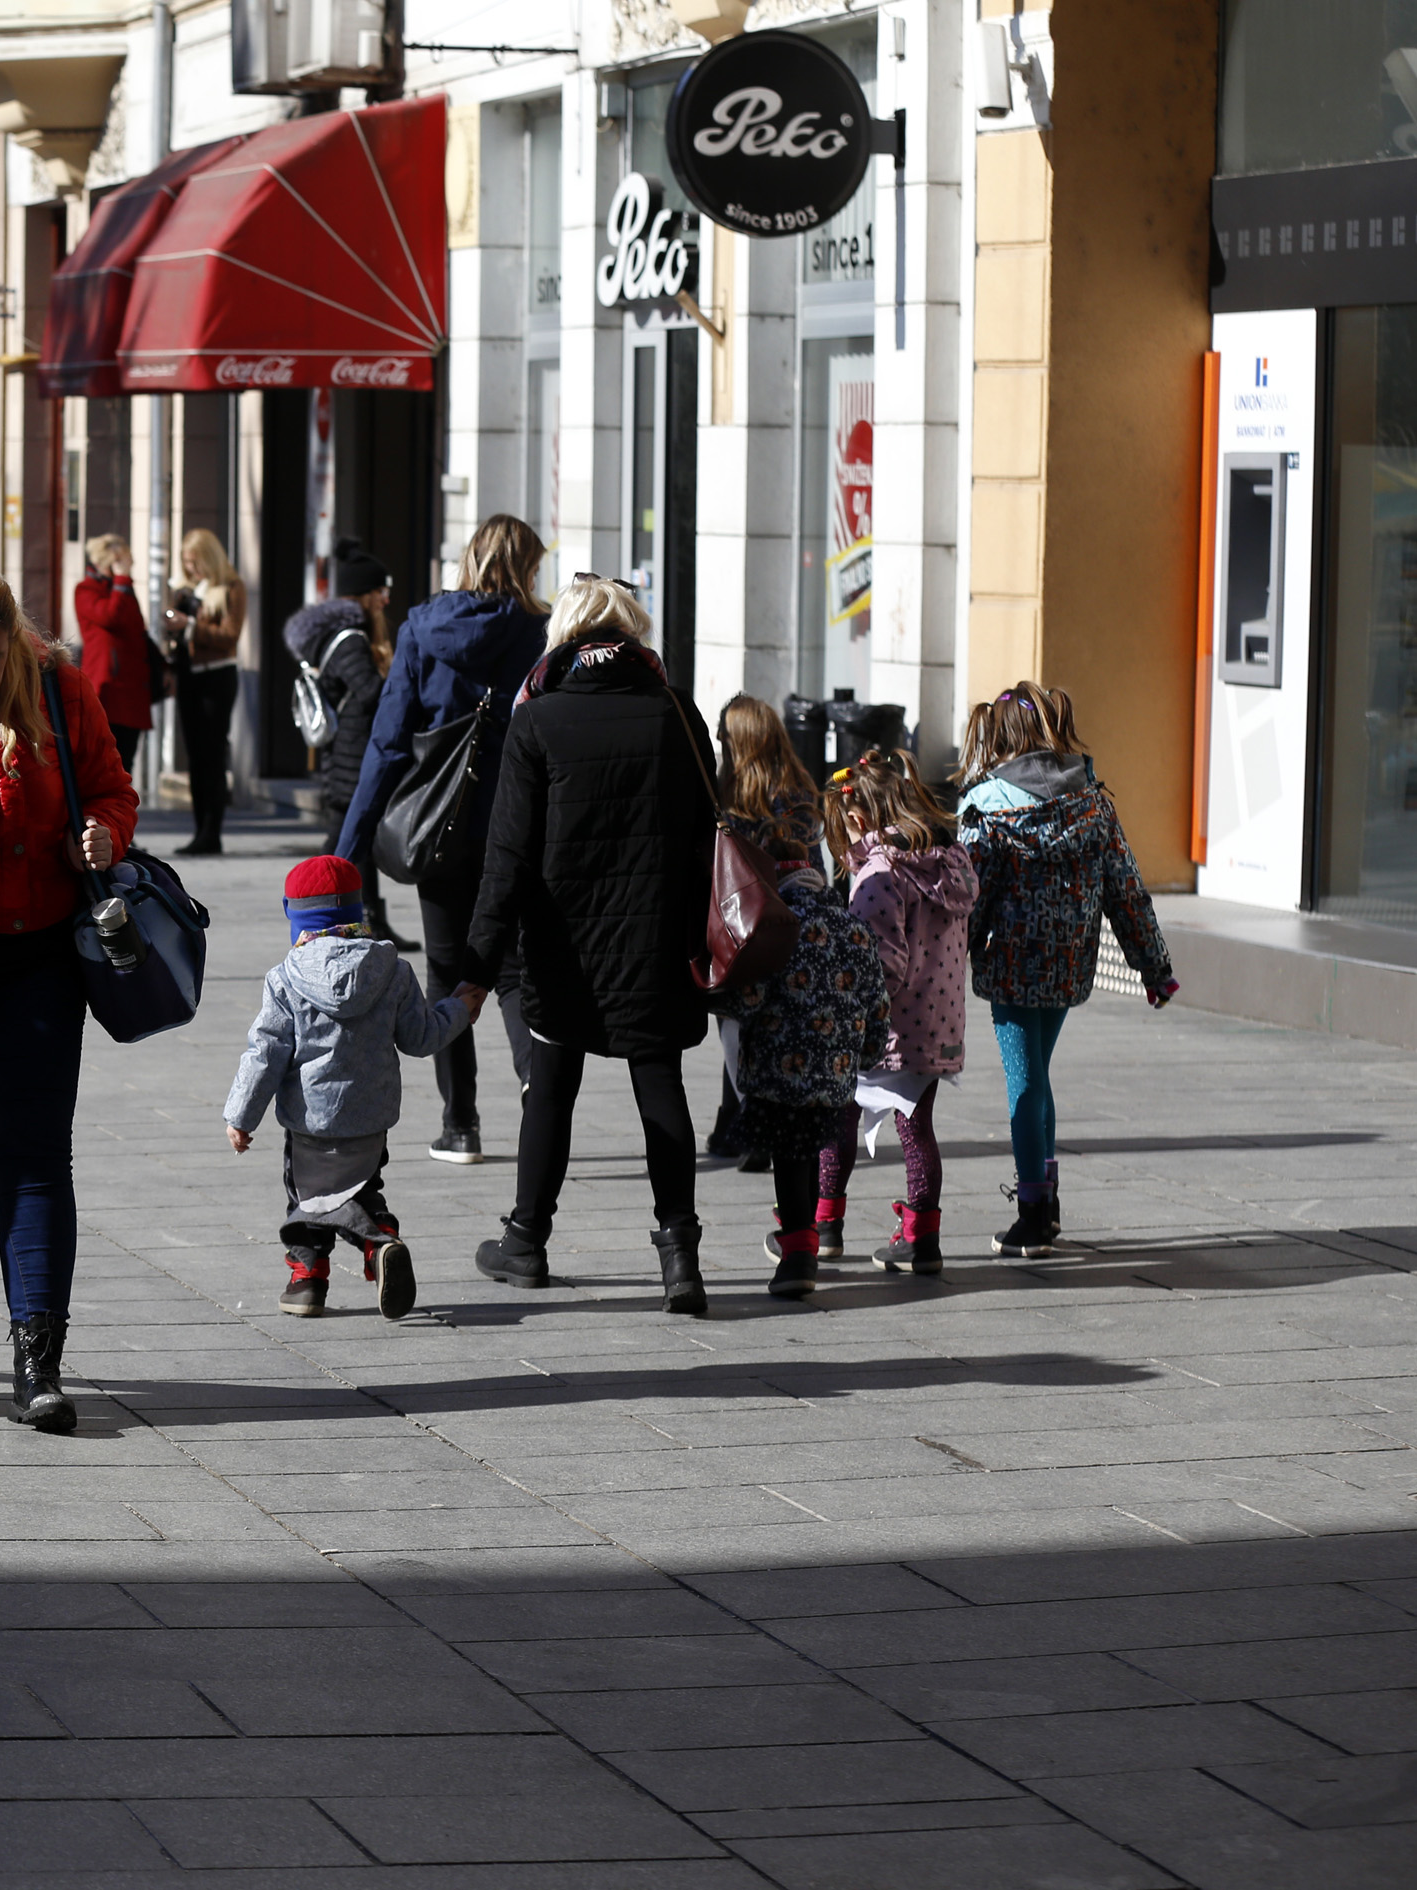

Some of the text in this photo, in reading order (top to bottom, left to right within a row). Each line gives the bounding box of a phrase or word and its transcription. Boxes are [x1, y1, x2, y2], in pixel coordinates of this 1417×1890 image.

[693, 86, 848, 159] Peko
[596, 171, 689, 307] Peko
[724, 202, 819, 230] since 1903
[813, 228, 859, 271] since
